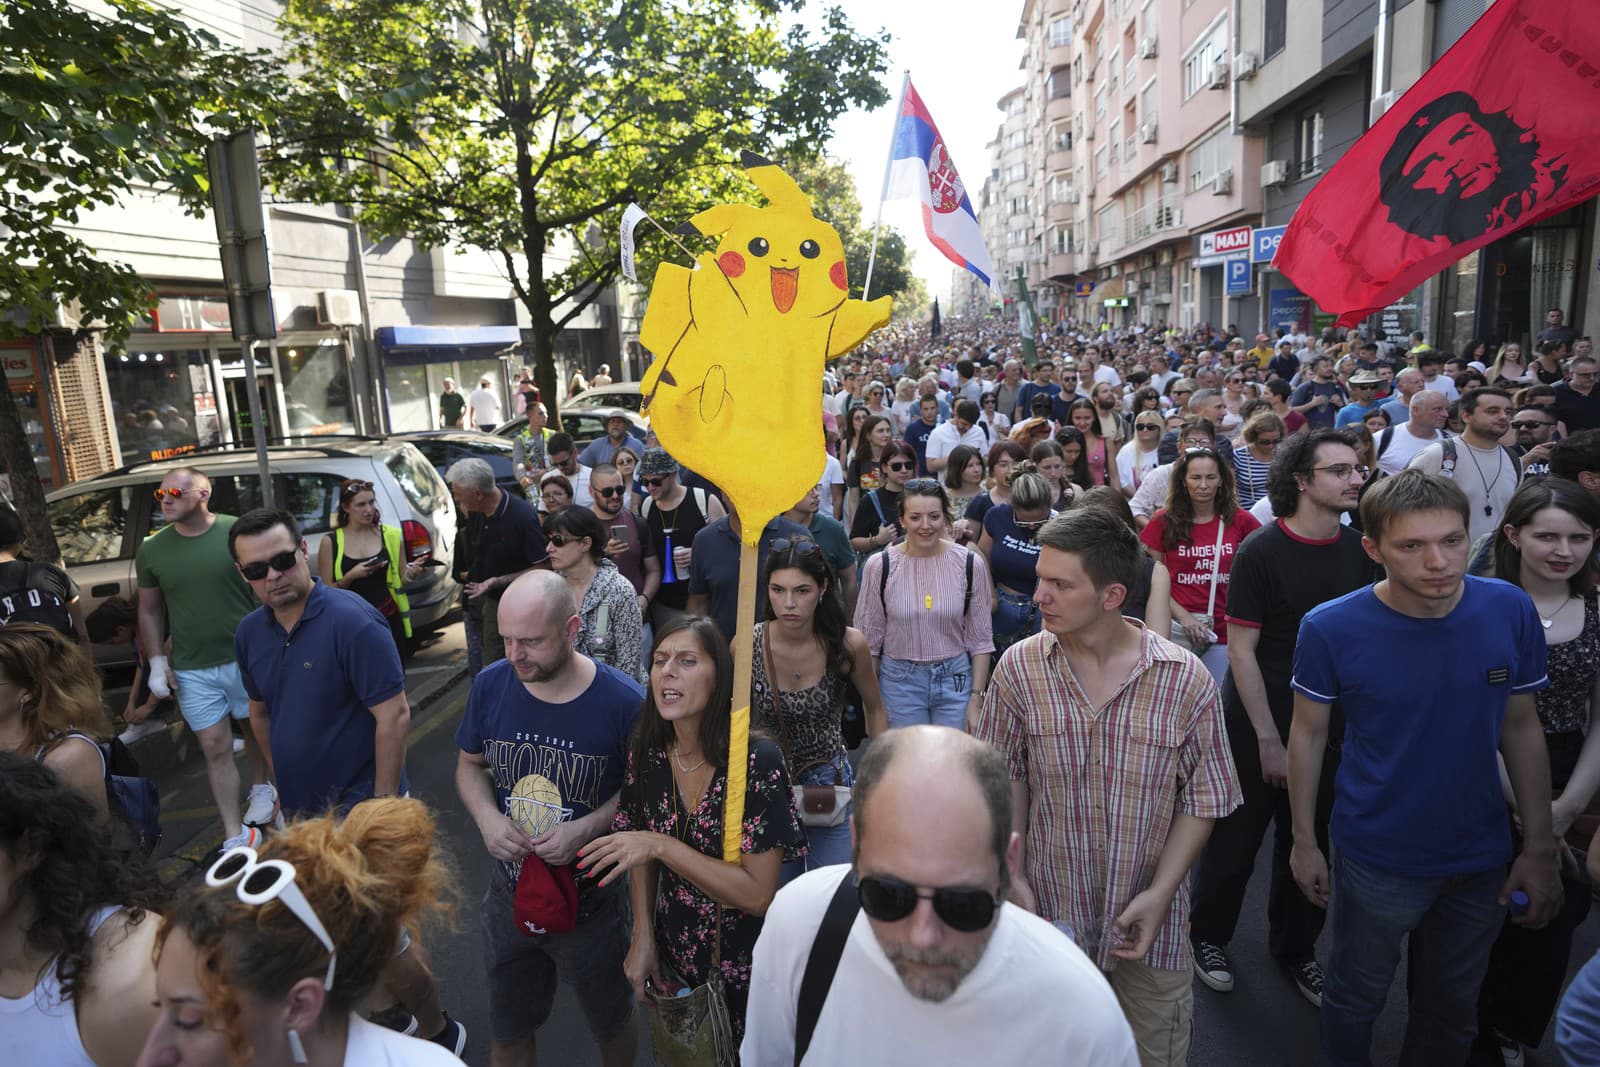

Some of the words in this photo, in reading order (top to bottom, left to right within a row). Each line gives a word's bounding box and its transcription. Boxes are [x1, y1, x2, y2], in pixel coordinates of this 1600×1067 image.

[1216, 230, 1248, 249] MAXI
[1232, 263, 1245, 280] P
[1195, 559, 1216, 571] ARE
[1177, 573, 1230, 585] CHAMPONS
[516, 732, 539, 742] EST
